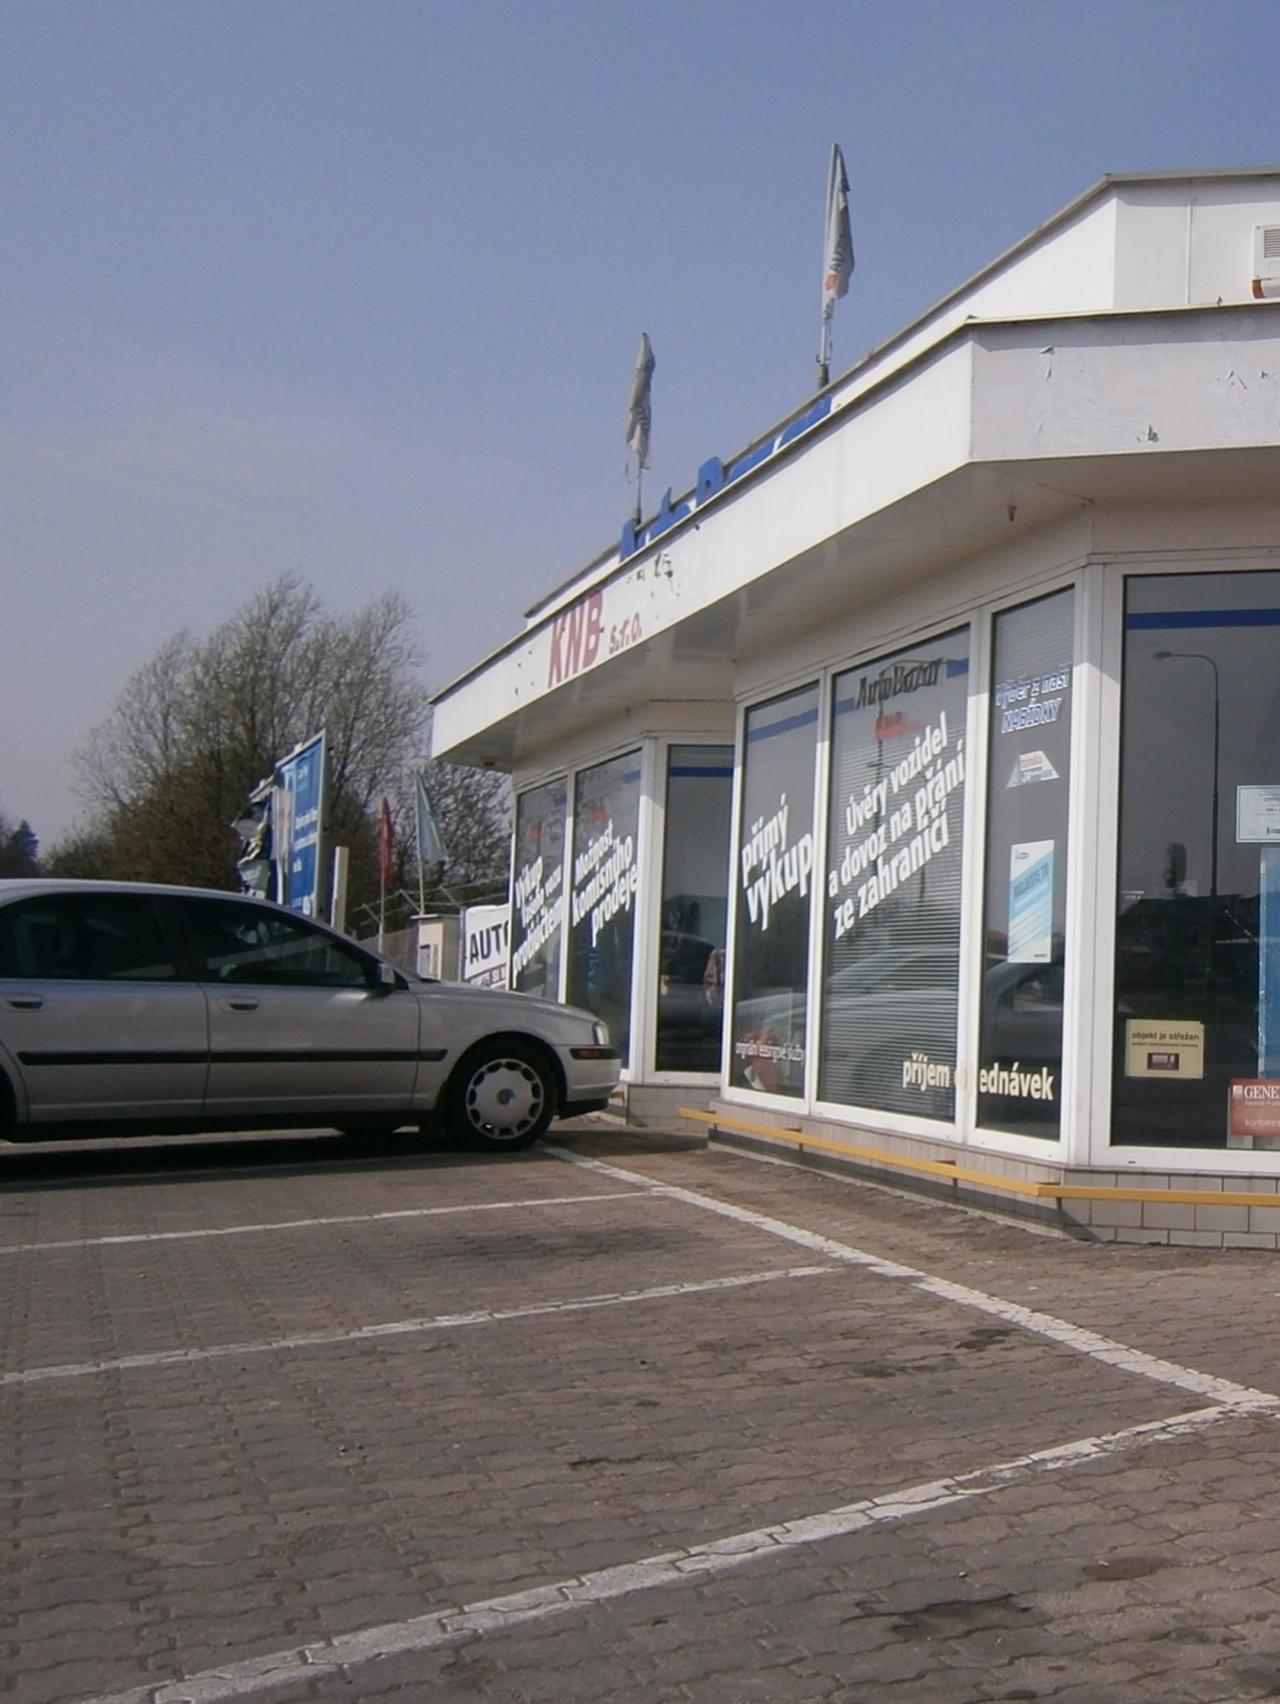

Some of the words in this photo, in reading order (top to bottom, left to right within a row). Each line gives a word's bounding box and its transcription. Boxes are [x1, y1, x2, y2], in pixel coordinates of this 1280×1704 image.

[548, 591, 603, 688] KNB
[828, 870, 839, 897] a
[841, 824, 888, 886] dovoz
[890, 802, 912, 842] na
[915, 739, 964, 832] přání
[846, 778, 887, 836] Úvěry
[890, 711, 948, 793] vozidel
[742, 793, 788, 889] přímý
[747, 833, 812, 932] výkup
[834, 899, 855, 940] ze
[857, 797, 949, 918] zahraničí
[592, 864, 638, 948] prodeje
[902, 1052, 950, 1091] příjem
[955, 1062, 1054, 1100] ednávek
[1131, 1031, 1157, 1041] objekt
[1159, 1032, 1167, 1041] je
